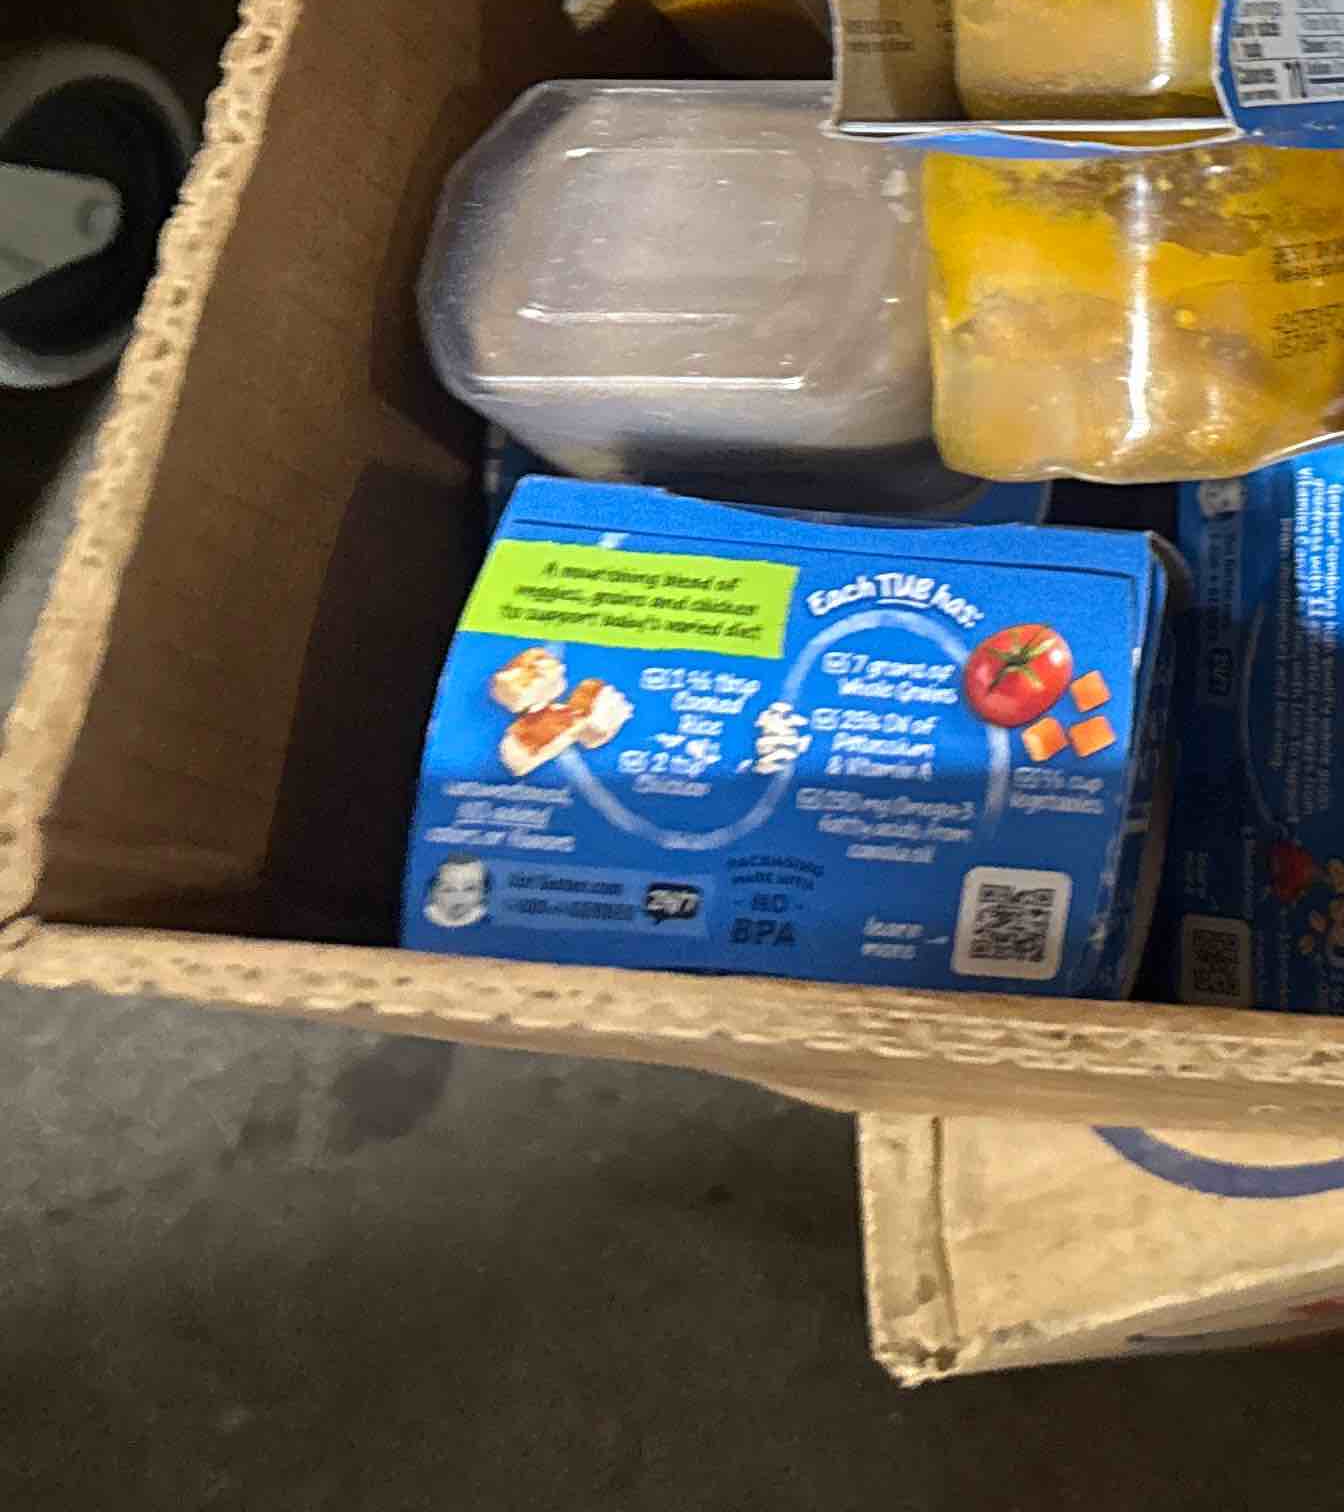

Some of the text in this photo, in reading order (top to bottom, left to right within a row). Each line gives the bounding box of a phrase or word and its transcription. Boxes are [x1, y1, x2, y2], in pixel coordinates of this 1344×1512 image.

[808, 574, 878, 616] Each
[931, 584, 985, 628] has:
[729, 920, 797, 949] BPA
